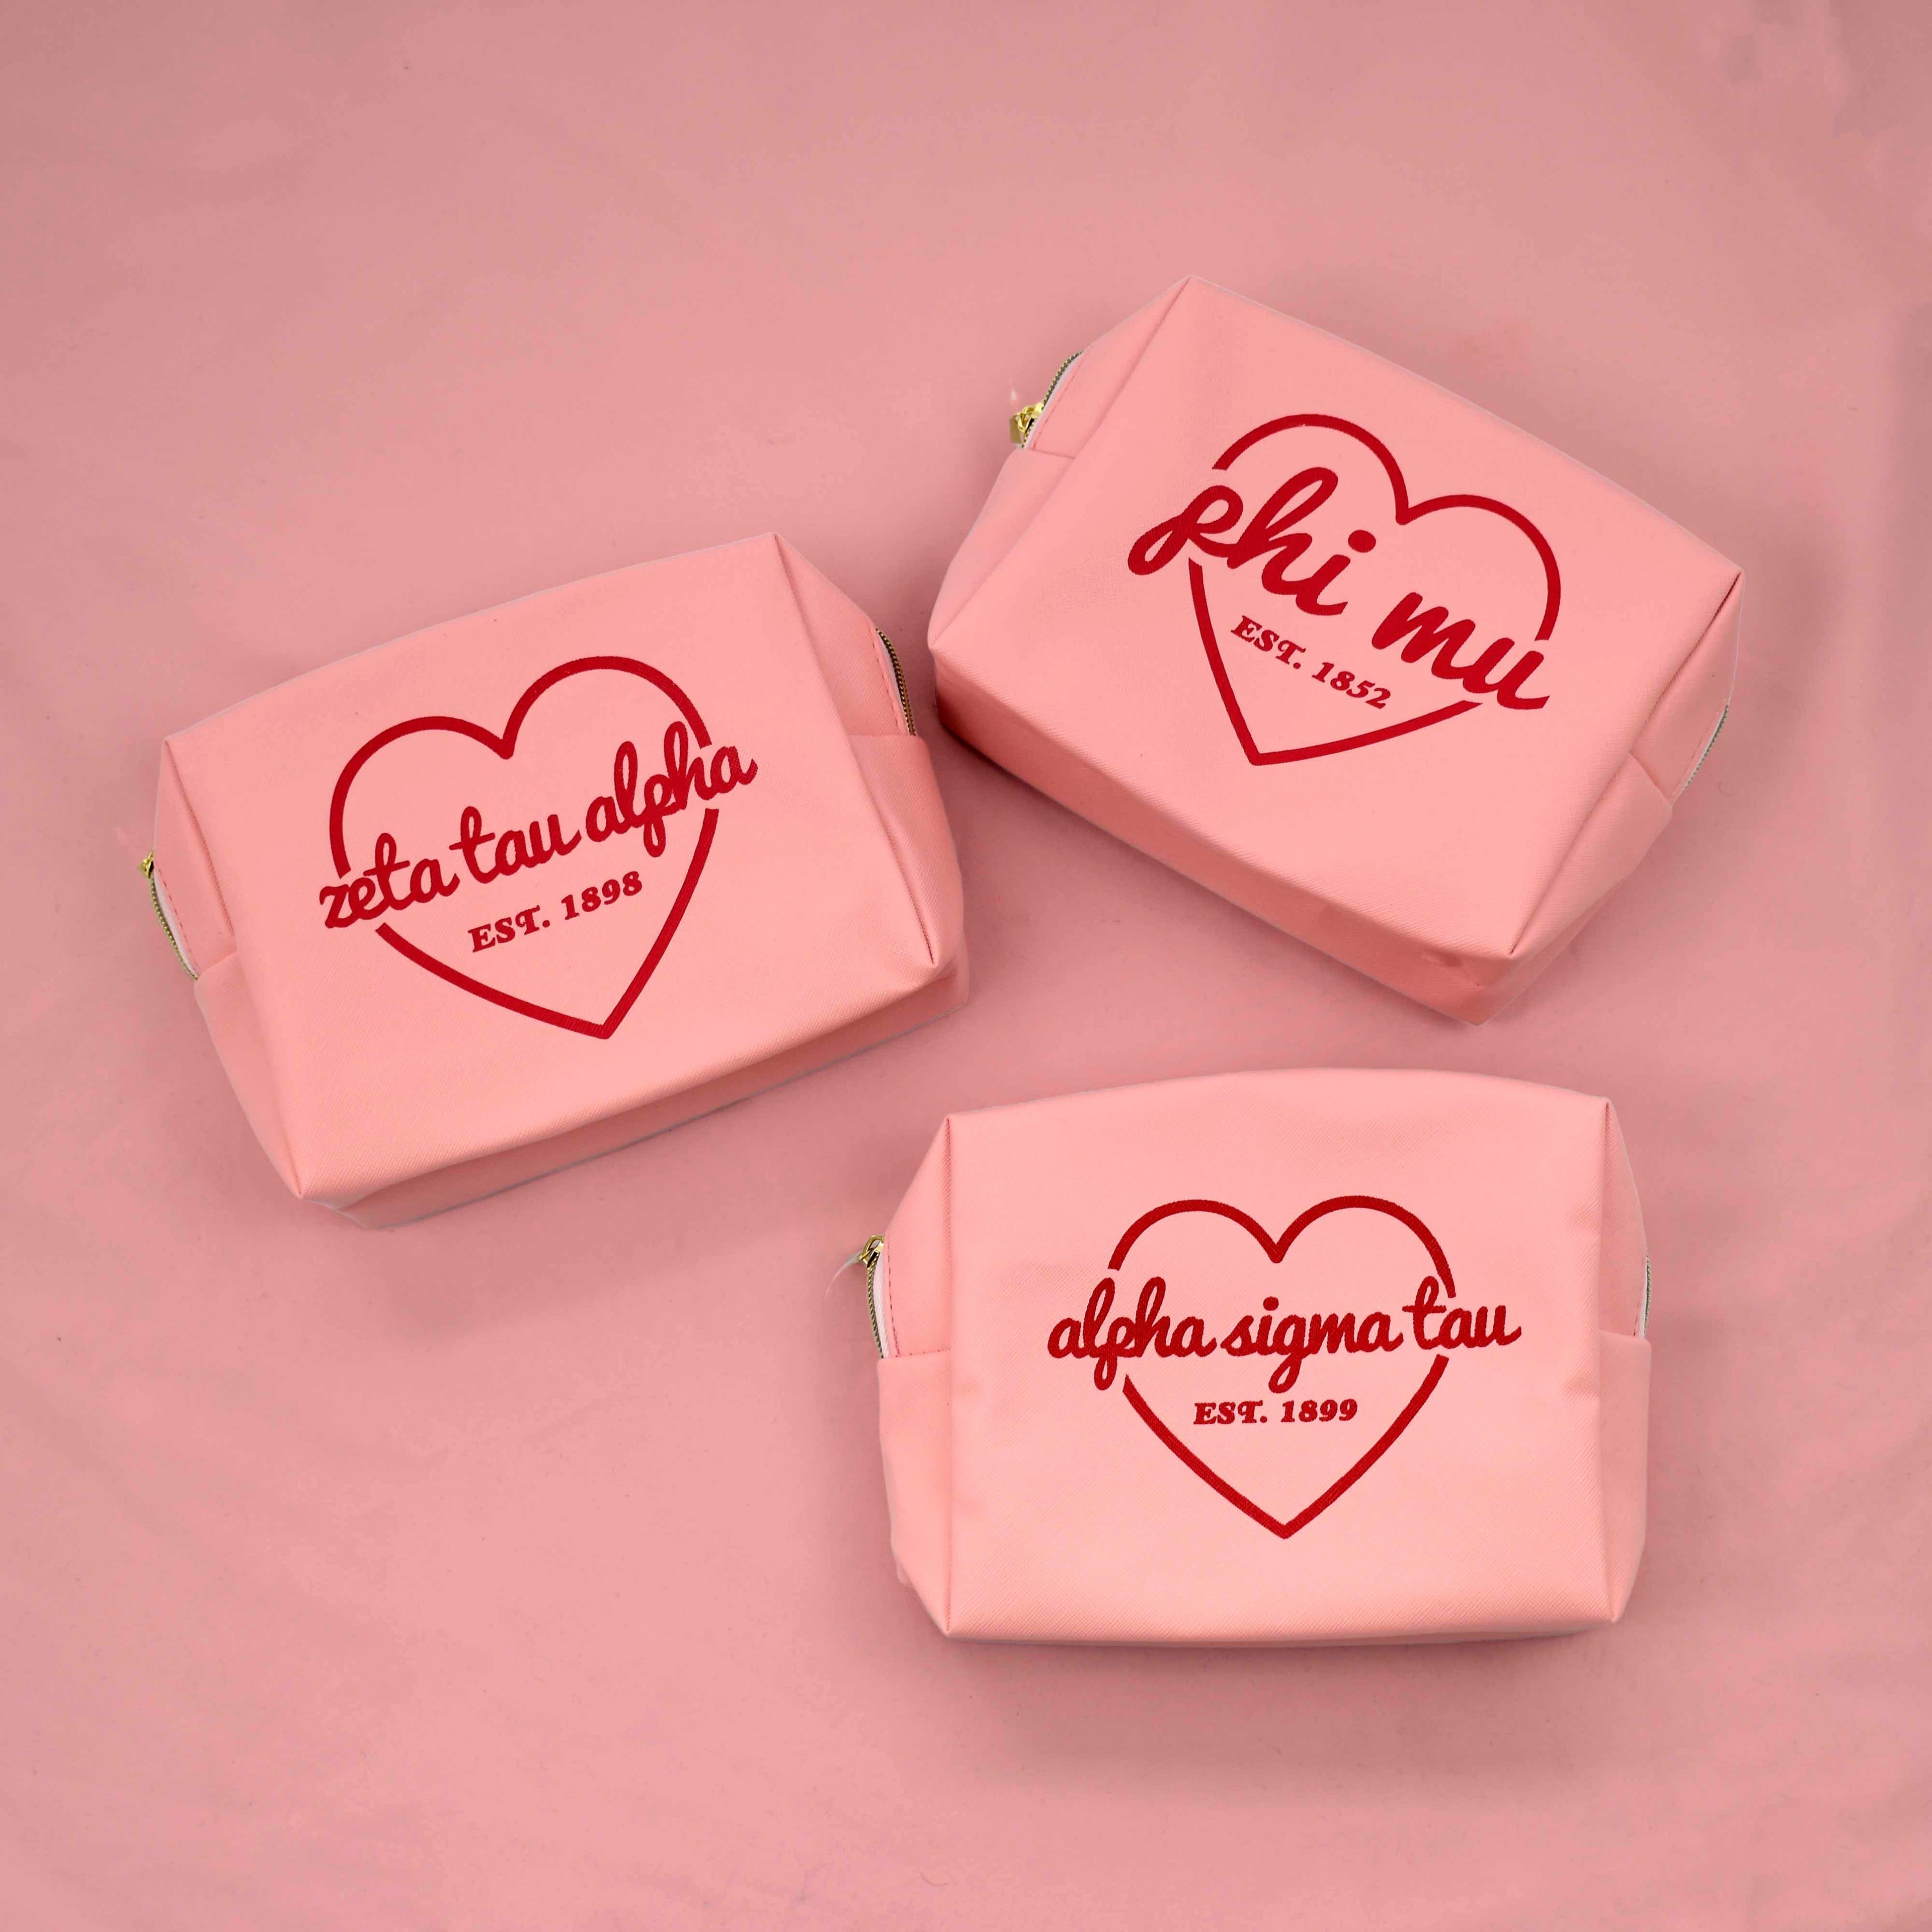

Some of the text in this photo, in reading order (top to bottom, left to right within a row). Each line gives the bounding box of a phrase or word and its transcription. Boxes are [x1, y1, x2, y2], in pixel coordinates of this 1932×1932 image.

[1127, 466, 1550, 710] phi mu
[1231, 615, 1391, 709] EST. 1852
[319, 720, 759, 929] zeta tau alpha
[467, 870, 643, 953] EST. 1898
[1047, 1275, 1522, 1394] alpha sigma tau
[1193, 1398, 1358, 1425] EST. 1899
